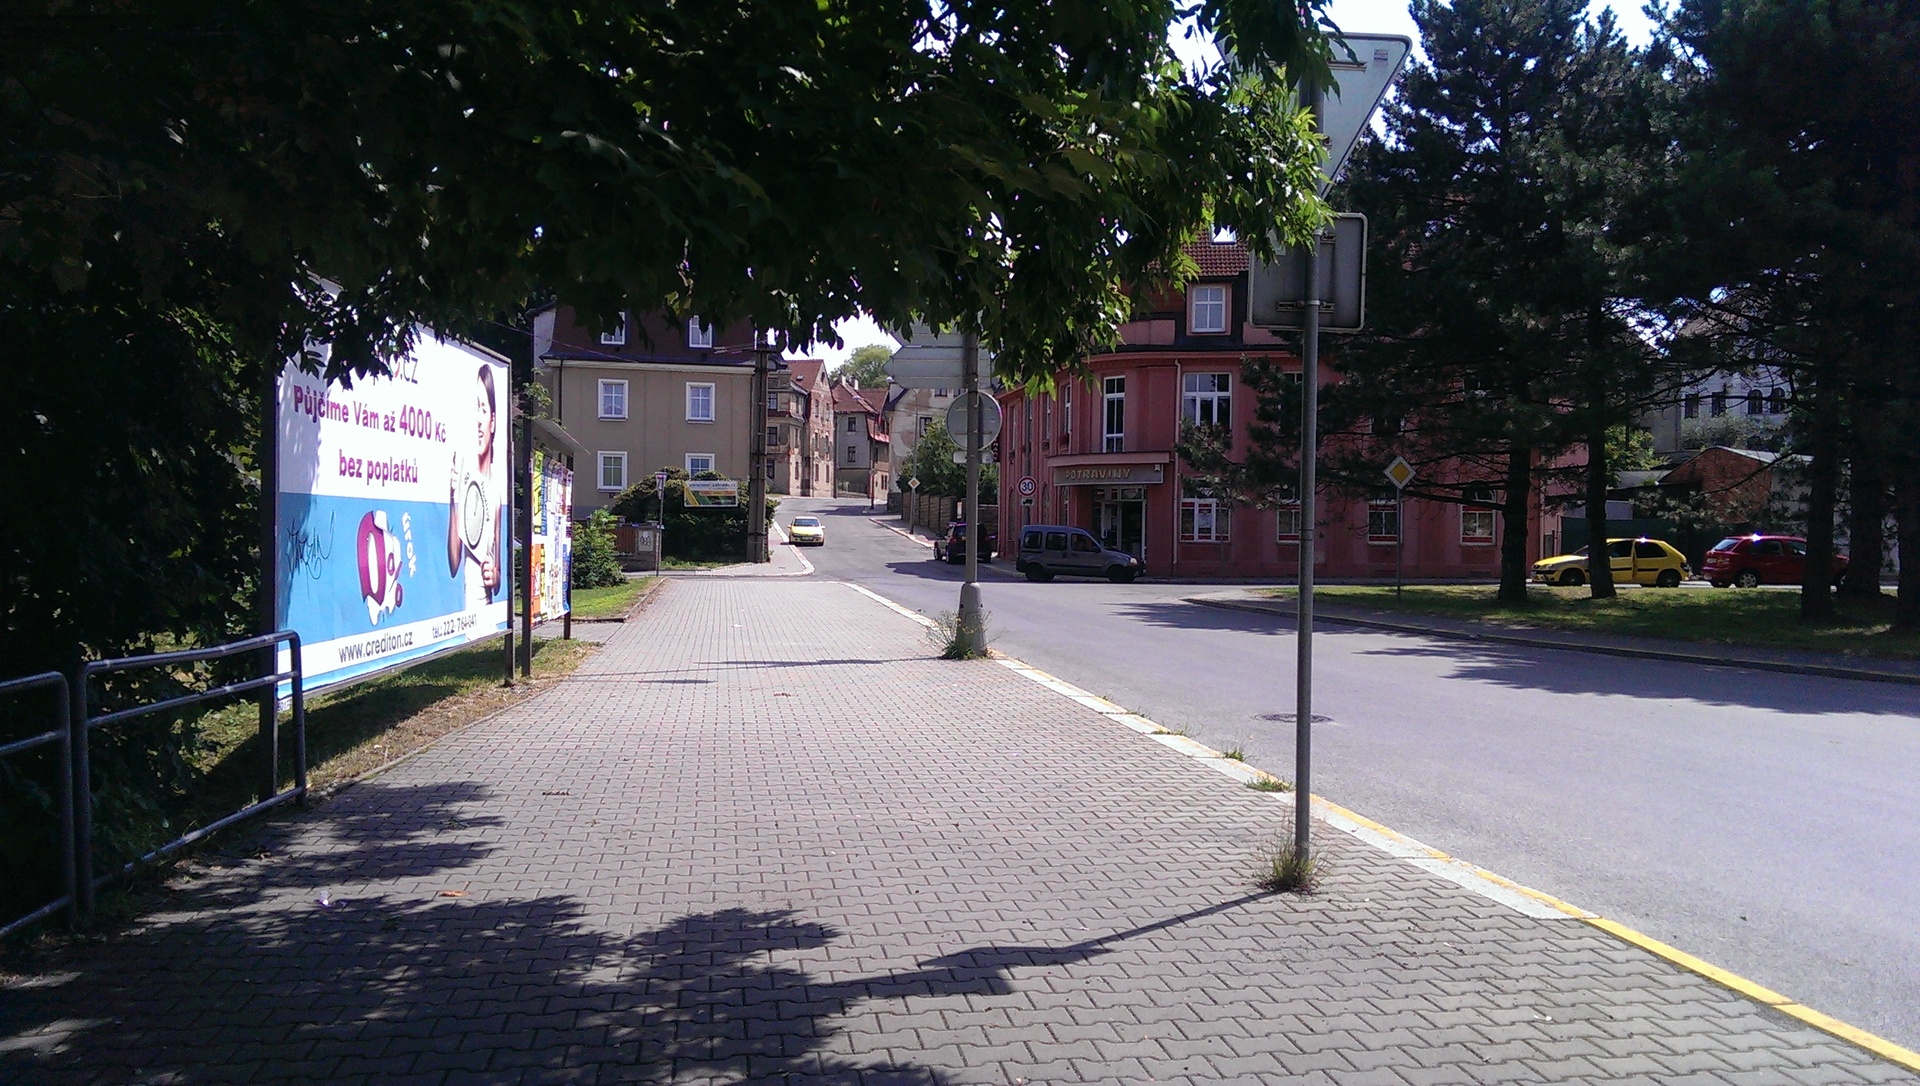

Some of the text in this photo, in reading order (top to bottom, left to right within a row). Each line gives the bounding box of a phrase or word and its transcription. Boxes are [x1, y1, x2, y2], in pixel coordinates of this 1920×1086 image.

[293, 384, 447, 443] Půjčíme Vám až 4000 Kč
[339, 448, 418, 487] bez poplatků
[1065, 467, 1132, 479] POTRAVINY
[1021, 481, 1034, 492] 30
[337, 631, 413, 664] www.crediton.cz
